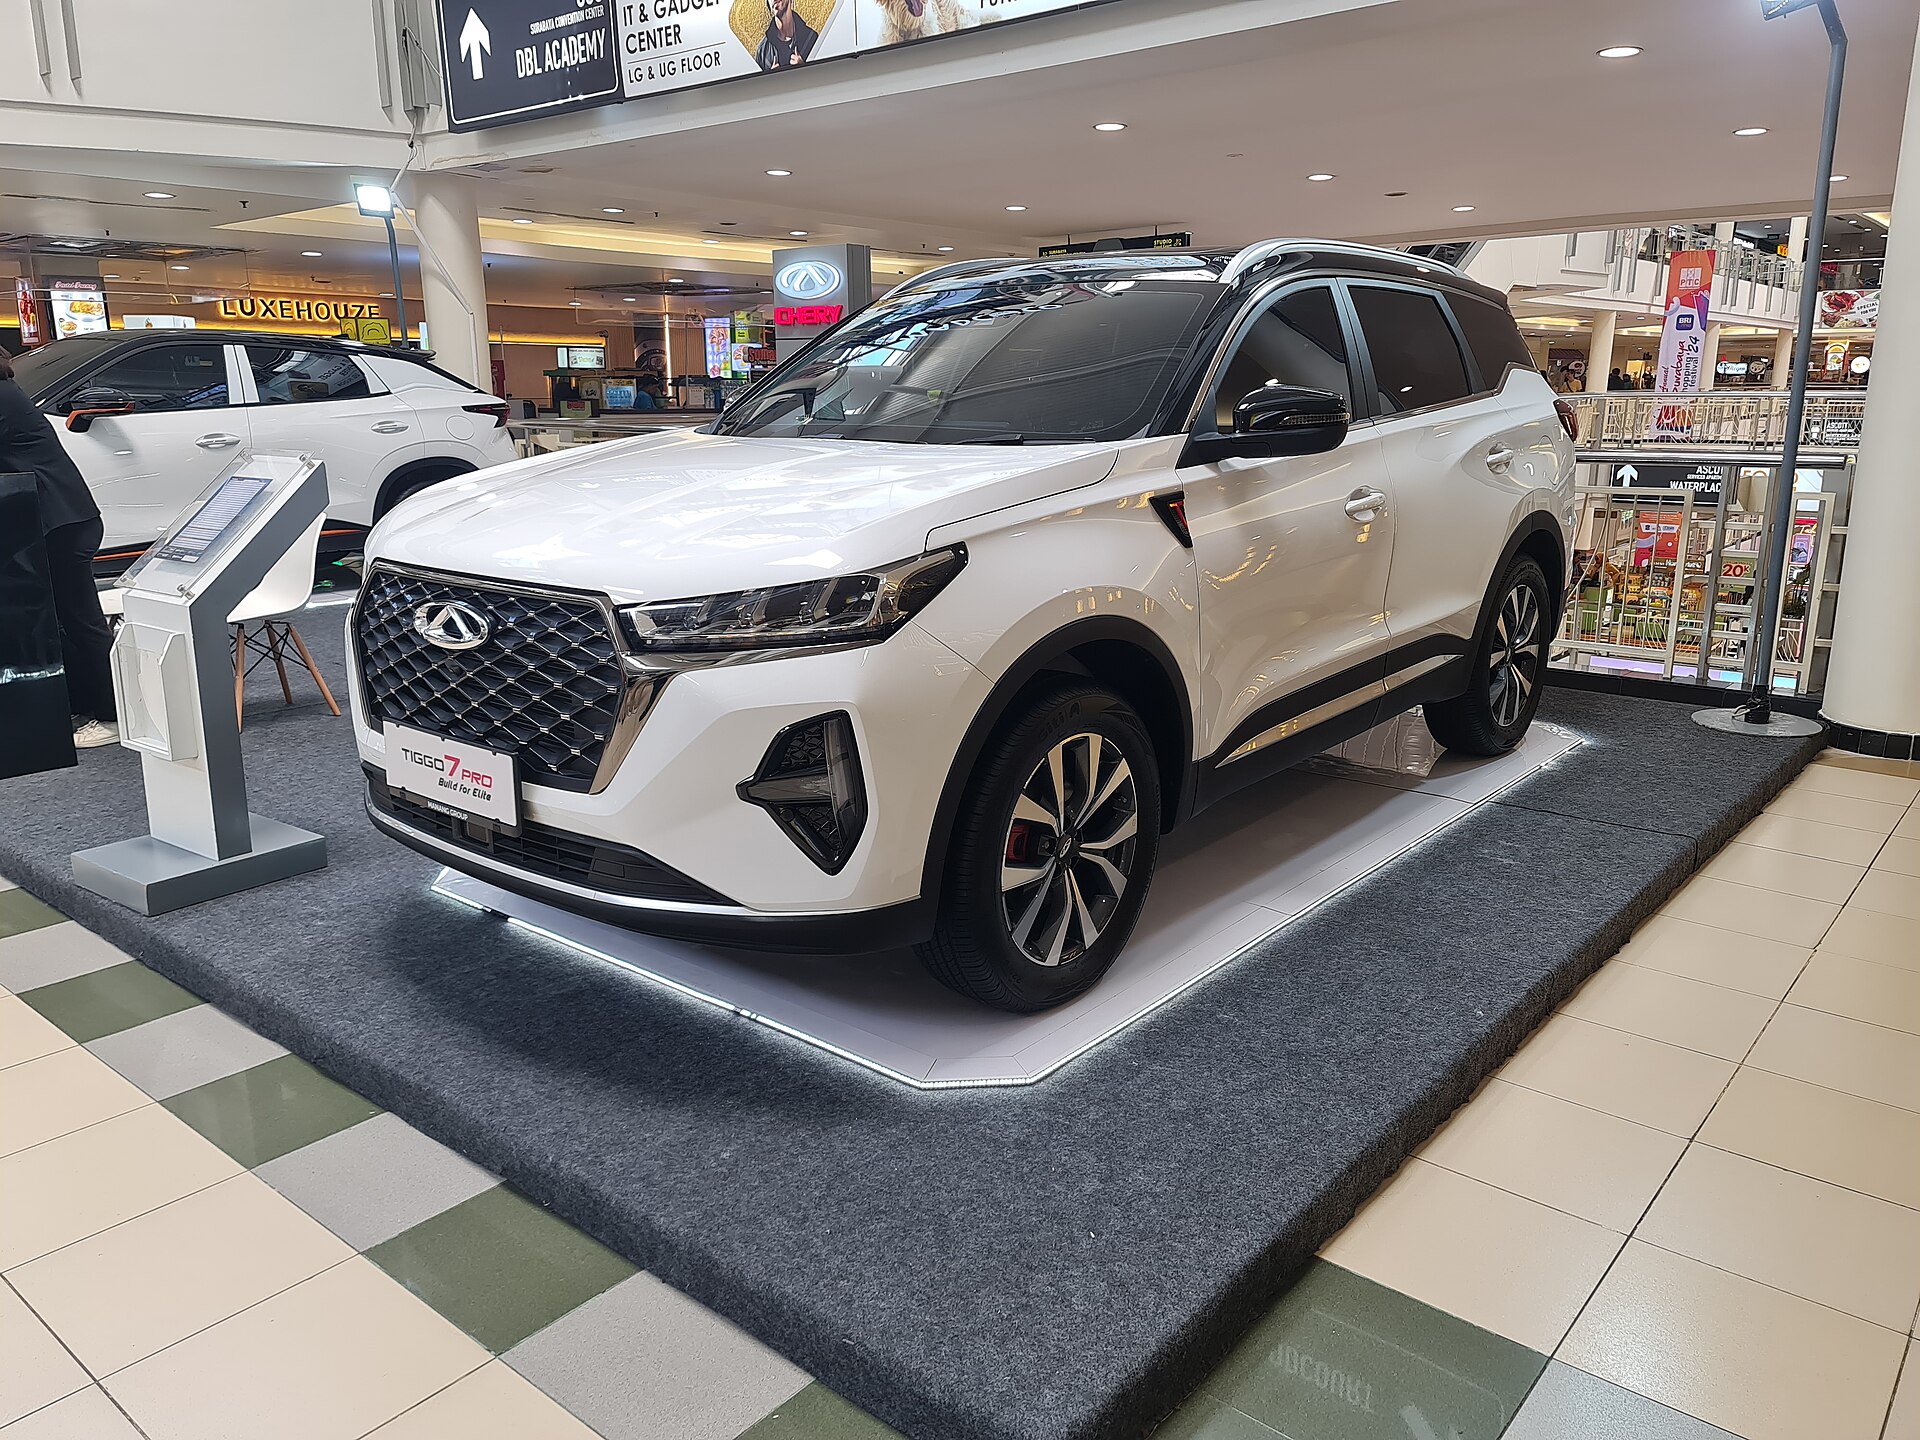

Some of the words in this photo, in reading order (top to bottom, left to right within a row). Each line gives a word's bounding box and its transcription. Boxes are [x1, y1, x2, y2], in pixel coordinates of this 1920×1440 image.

[530, 17, 555, 35] SURABAYA
[554, 9, 585, 29] CONVENTION
[584, 5, 605, 21] CENTER
[623, 5, 633, 27] IT
[639, 3, 649, 23] &
[625, 23, 682, 55] CENTER
[515, 45, 542, 79] DBL
[544, 28, 605, 72] ACADEMY
[628, 67, 643, 84] LG
[647, 65, 655, 80] &
[659, 60, 676, 77] UG
[681, 51, 721, 74] FLOOR
[223, 299, 380, 320] LUXEHOUZE
[774, 304, 844, 326] CHERY
[1856, 302, 1878, 311] SPECIAL
[1689, 356, 1699, 387] festival
[1669, 480, 1722, 493] WATERPLAC
[401, 747, 445, 772] TIGGO
[443, 754, 461, 777] 7
[461, 768, 493, 789] PRO
[438, 777, 459, 791] Build
[472, 788, 492, 802] Elite
[449, 808, 469, 821] GROUP
